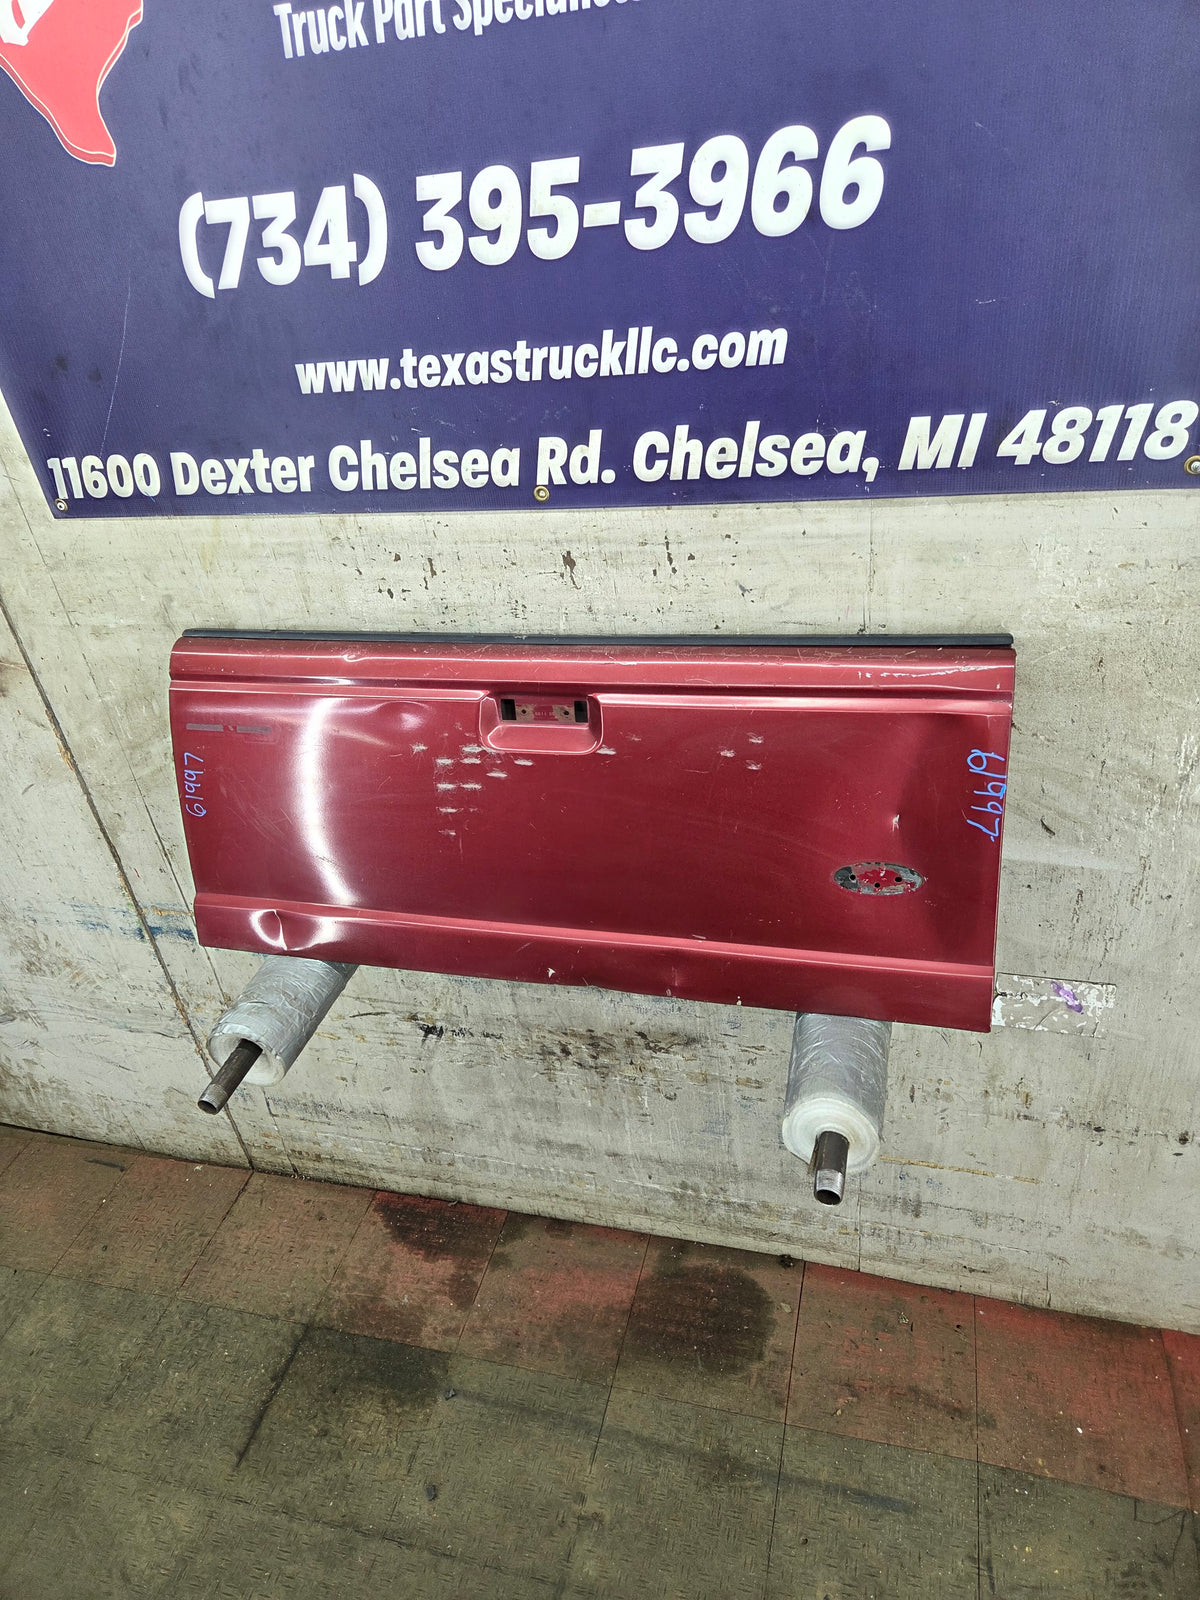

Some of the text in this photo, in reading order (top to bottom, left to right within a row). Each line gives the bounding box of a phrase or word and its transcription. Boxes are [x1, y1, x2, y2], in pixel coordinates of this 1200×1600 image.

[273, 0, 370, 59] Truck
[373, 0, 446, 44] Part
[178, 114, 891, 299] (734) 395-3966
[295, 326, 788, 394] www.texastruckllc.com
[47, 400, 1199, 499] 11600 Dexter Chelsea Rd. Chelsea, MI 48118
[183, 752, 207, 817] 61997
[966, 749, 1007, 842] 61997
